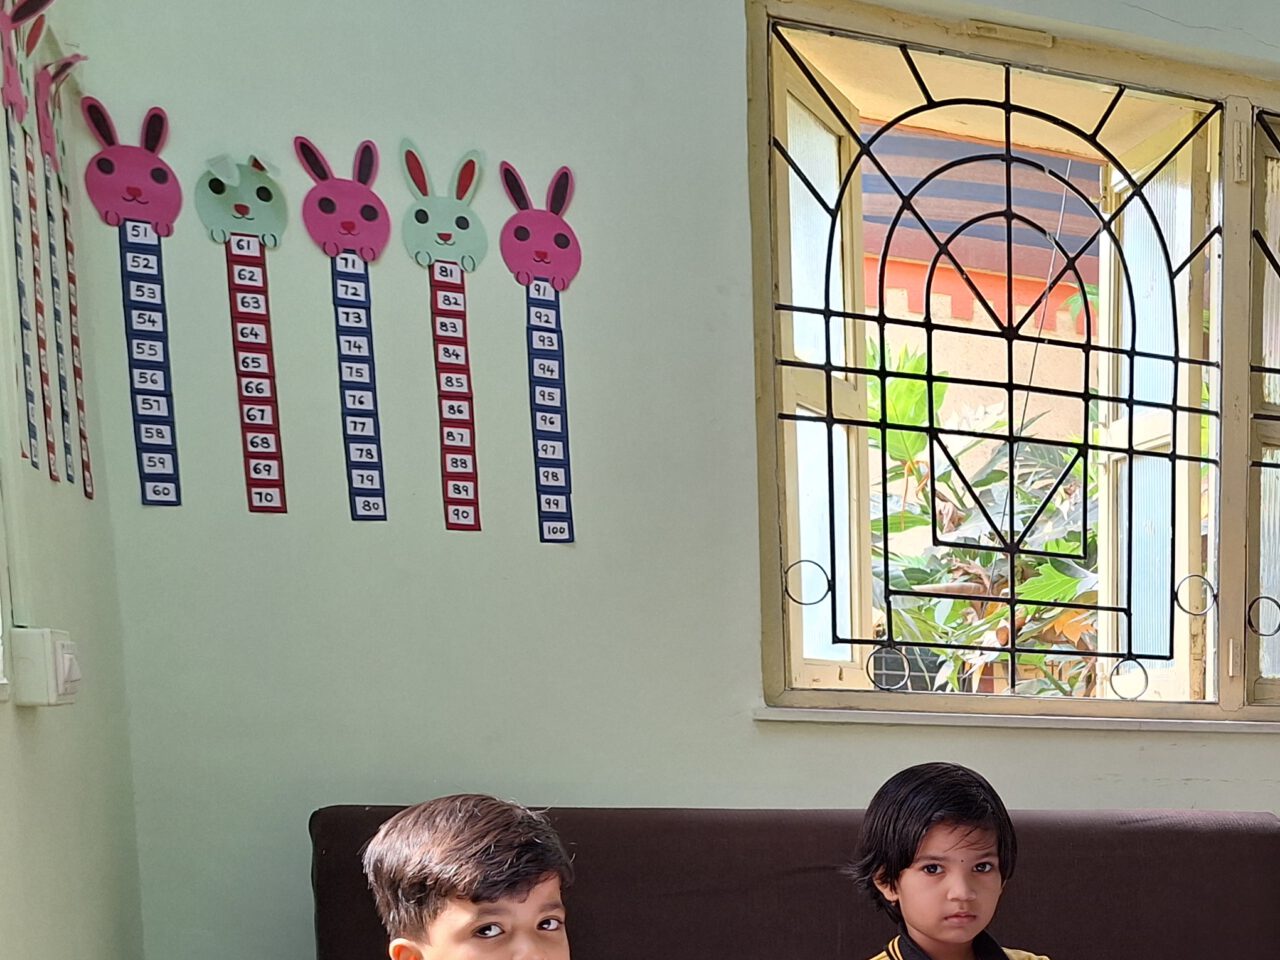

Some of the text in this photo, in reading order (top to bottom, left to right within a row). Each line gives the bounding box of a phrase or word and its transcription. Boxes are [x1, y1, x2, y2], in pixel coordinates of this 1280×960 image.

[131, 224, 148, 238] 51
[235, 238, 251, 251] 61
[130, 255, 155, 270] 52
[339, 256, 356, 270] 71
[237, 268, 258, 282] 62
[438, 265, 454, 278] 81
[135, 284, 157, 300] 53
[339, 283, 361, 297] 72
[533, 283, 547, 297] 91
[240, 295, 261, 310] 63
[442, 294, 462, 307] 82
[136, 312, 158, 328] 54
[341, 311, 363, 324] 73
[534, 310, 553, 325] 92
[239, 326, 260, 340] 64
[439, 321, 458, 334] 83
[343, 339, 363, 353] 74
[538, 334, 555, 347] 93
[135, 342, 158, 357] 55
[442, 346, 461, 361] 84
[241, 356, 262, 369] 65
[345, 365, 364, 378] 75
[538, 362, 556, 377] 94
[137, 371, 159, 385] 56
[444, 375, 464, 388] 85
[244, 380, 265, 395] 66
[348, 394, 365, 406] 76
[538, 389, 555, 402] 95
[140, 397, 161, 412] 57
[447, 404, 464, 415] 86
[245, 406, 266, 422] 67
[540, 414, 556, 426] 96
[144, 426, 166, 440] 58
[349, 420, 367, 433] 77
[249, 435, 271, 450] 68
[445, 430, 464, 443] 87
[354, 447, 375, 460] 78
[540, 443, 556, 456] 97
[146, 455, 166, 469] 59
[450, 457, 468, 469] 88
[252, 462, 273, 477] 69
[542, 470, 560, 482] 98
[356, 473, 375, 486] 79
[151, 484, 171, 497] 60
[452, 483, 469, 497] 89
[253, 491, 274, 504] 70
[544, 497, 560, 510] 99
[361, 499, 380, 512] 80
[452, 508, 470, 521] 90
[547, 525, 566, 535] 100
